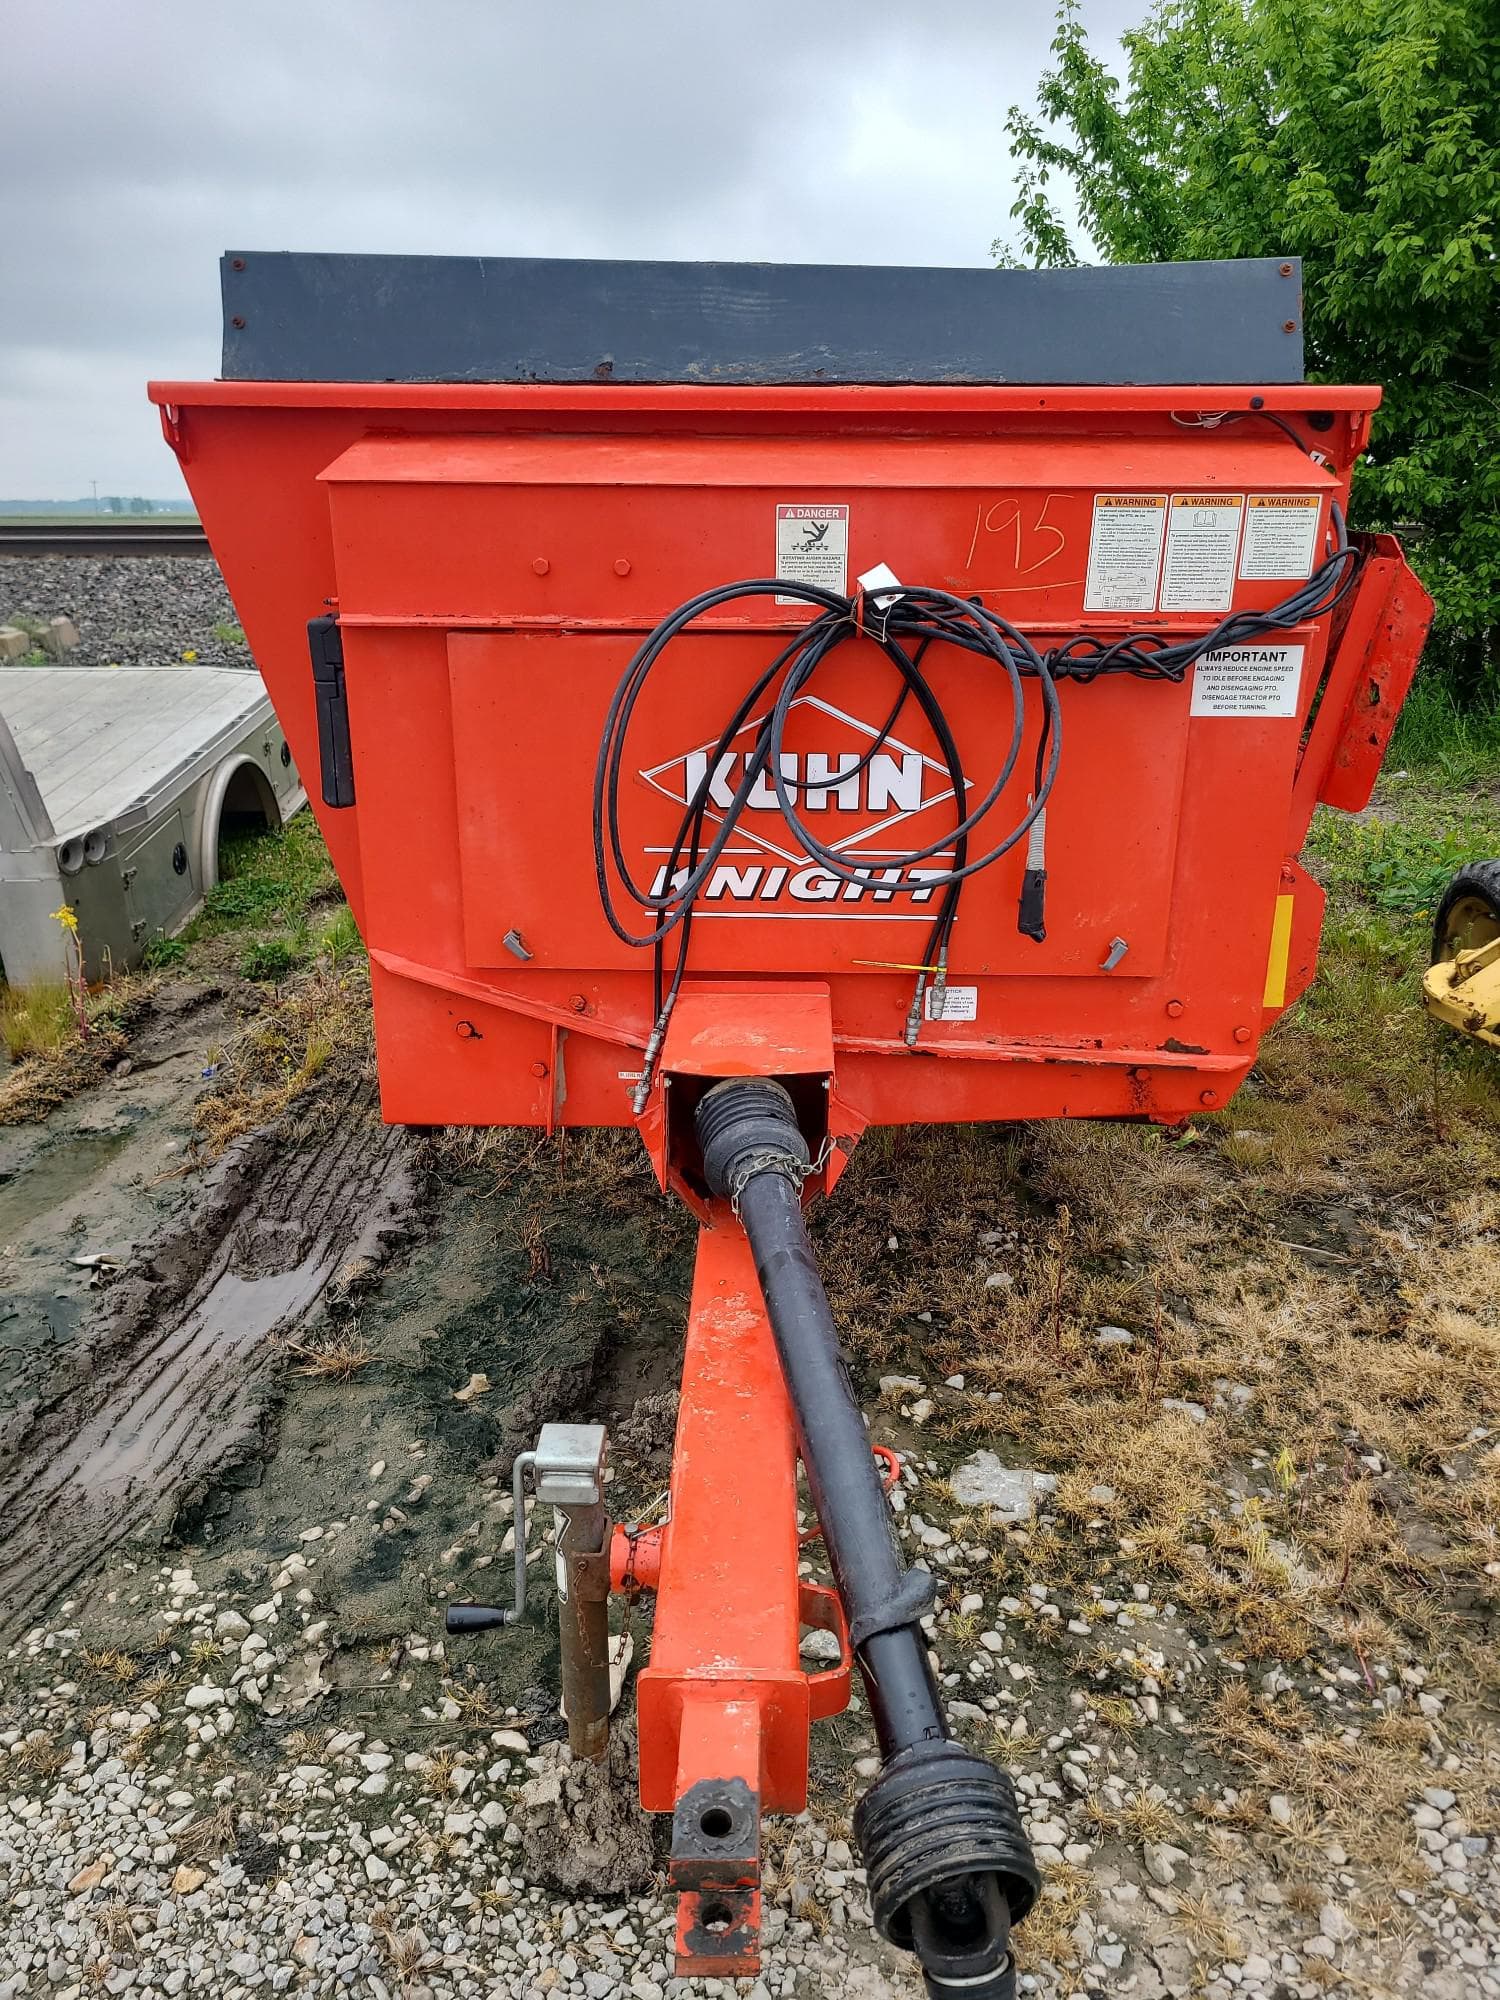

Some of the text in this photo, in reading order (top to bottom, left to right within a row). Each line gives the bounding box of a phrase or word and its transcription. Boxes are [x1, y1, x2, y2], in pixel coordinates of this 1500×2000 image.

[797, 509, 839, 518] DANGER
[966, 494, 1074, 574] 195
[1206, 651, 1287, 662] IMPORTANT
[686, 752, 923, 811] KUHN
[649, 865, 952, 902] KNIGHT
